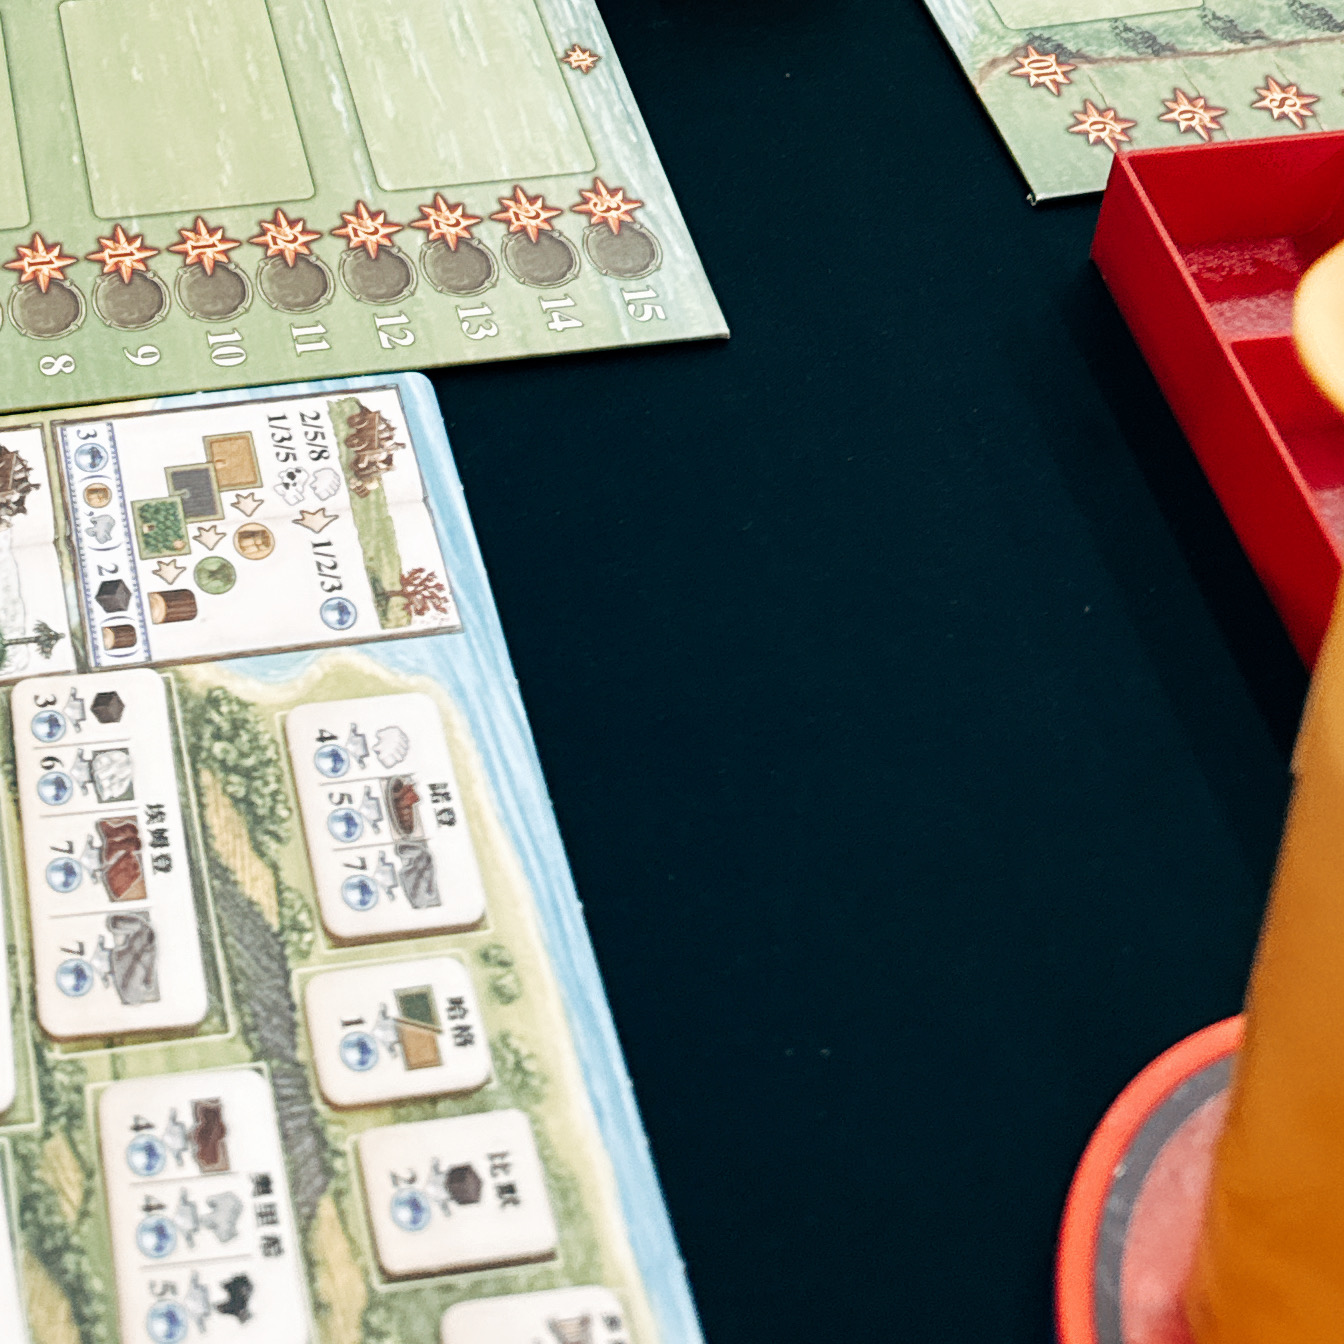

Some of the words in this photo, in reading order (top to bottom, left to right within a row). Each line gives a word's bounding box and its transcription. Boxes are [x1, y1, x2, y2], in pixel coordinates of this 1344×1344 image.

[39, 354, 76, 377] 8
[123, 345, 161, 367] 9
[206, 328, 247, 368] 10
[289, 322, 332, 357] 11
[373, 312, 415, 350] 12
[456, 302, 499, 340] 13
[539, 294, 583, 332] 14
[621, 285, 667, 323] 15
[76, 428, 98, 440] 3
[267, 413, 297, 463] 1/3/5
[299, 409, 331, 462] 2/5/8
[96, 563, 119, 577] 2
[311, 539, 344, 594] 1/2/3
[33, 693, 57, 708] 3
[315, 728, 339, 743] 4
[328, 791, 353, 806] 5
[50, 840, 74, 855] 7
[342, 855, 368, 871] 7
[59, 940, 85, 957] 7
[340, 1016, 367, 1028] 1
[130, 1113, 156, 1131] 4
[389, 1168, 416, 1187] 2
[141, 1193, 167, 1212] 4
[148, 1278, 178, 1297] 5
